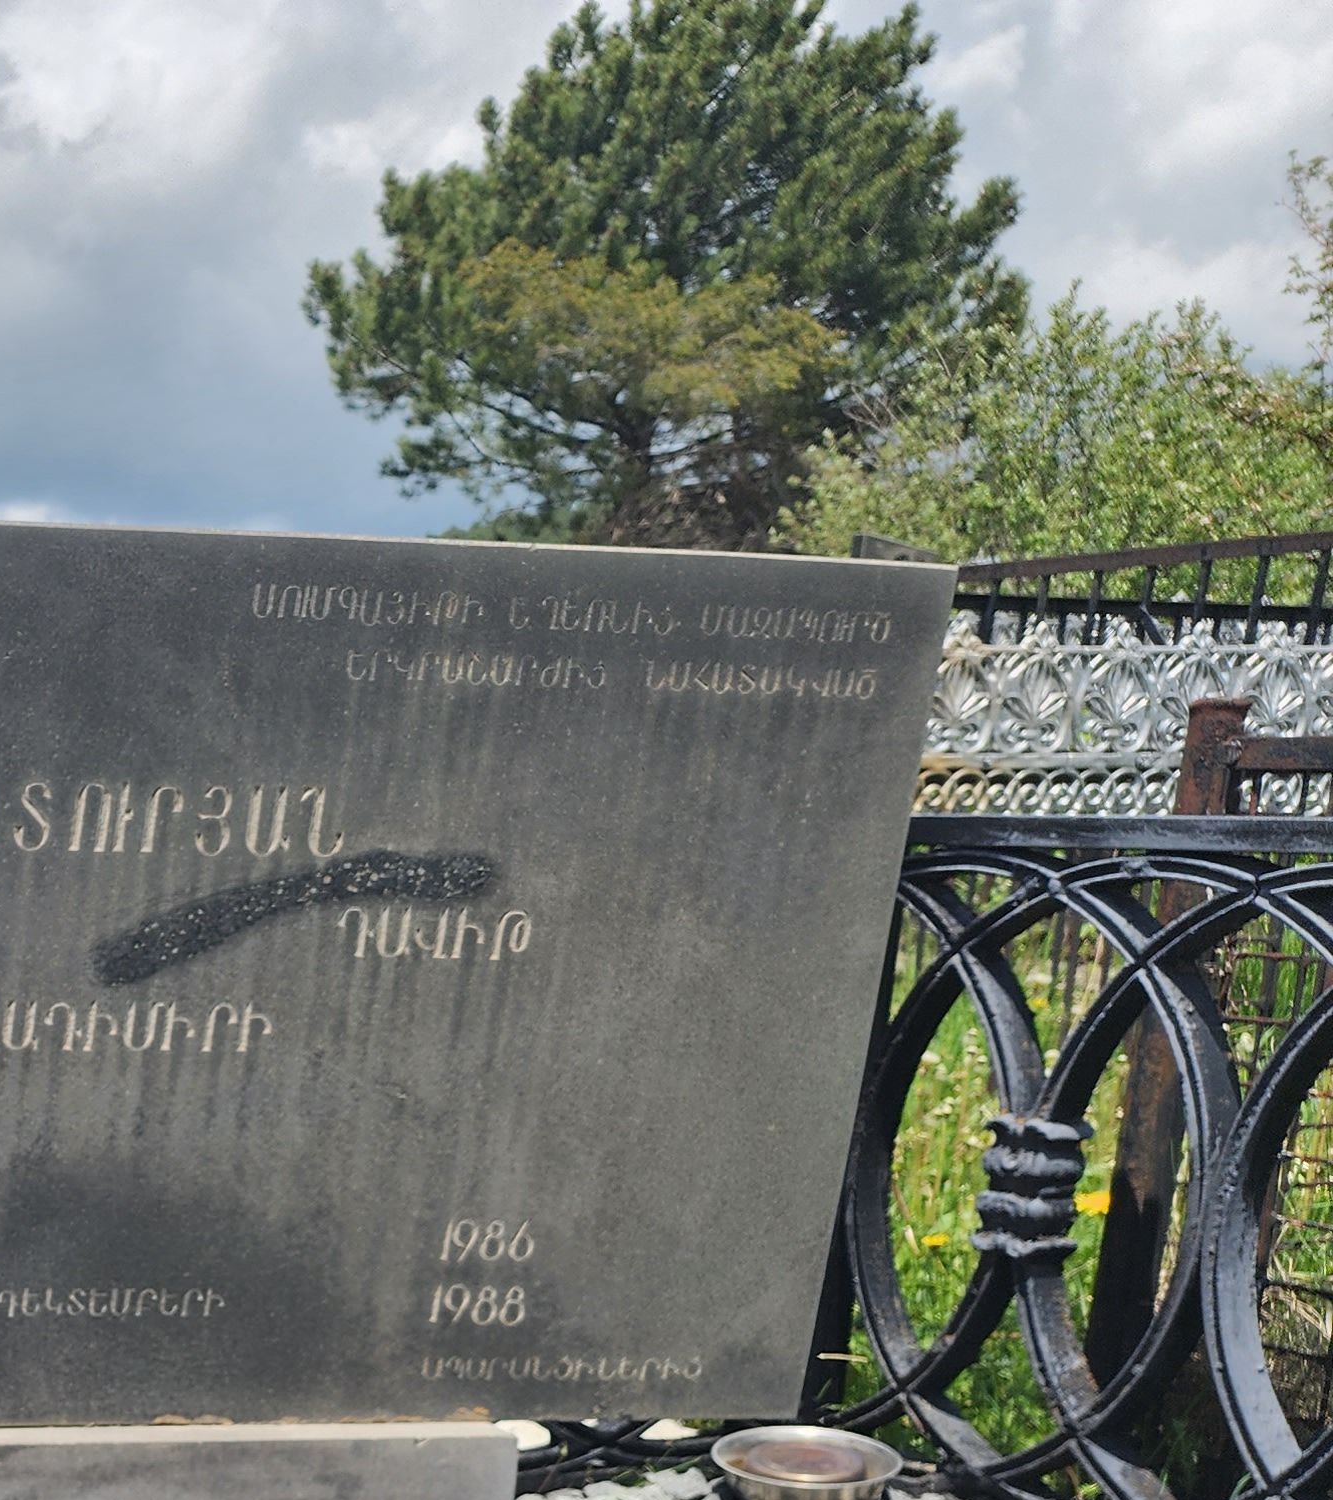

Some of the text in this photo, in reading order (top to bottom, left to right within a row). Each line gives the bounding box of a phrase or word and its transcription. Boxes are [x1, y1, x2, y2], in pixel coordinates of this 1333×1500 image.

[337, 905, 533, 961] ԴԱՎԻԹ
[439, 1218, 535, 1263] 1986
[428, 1283, 526, 1327] 1988
